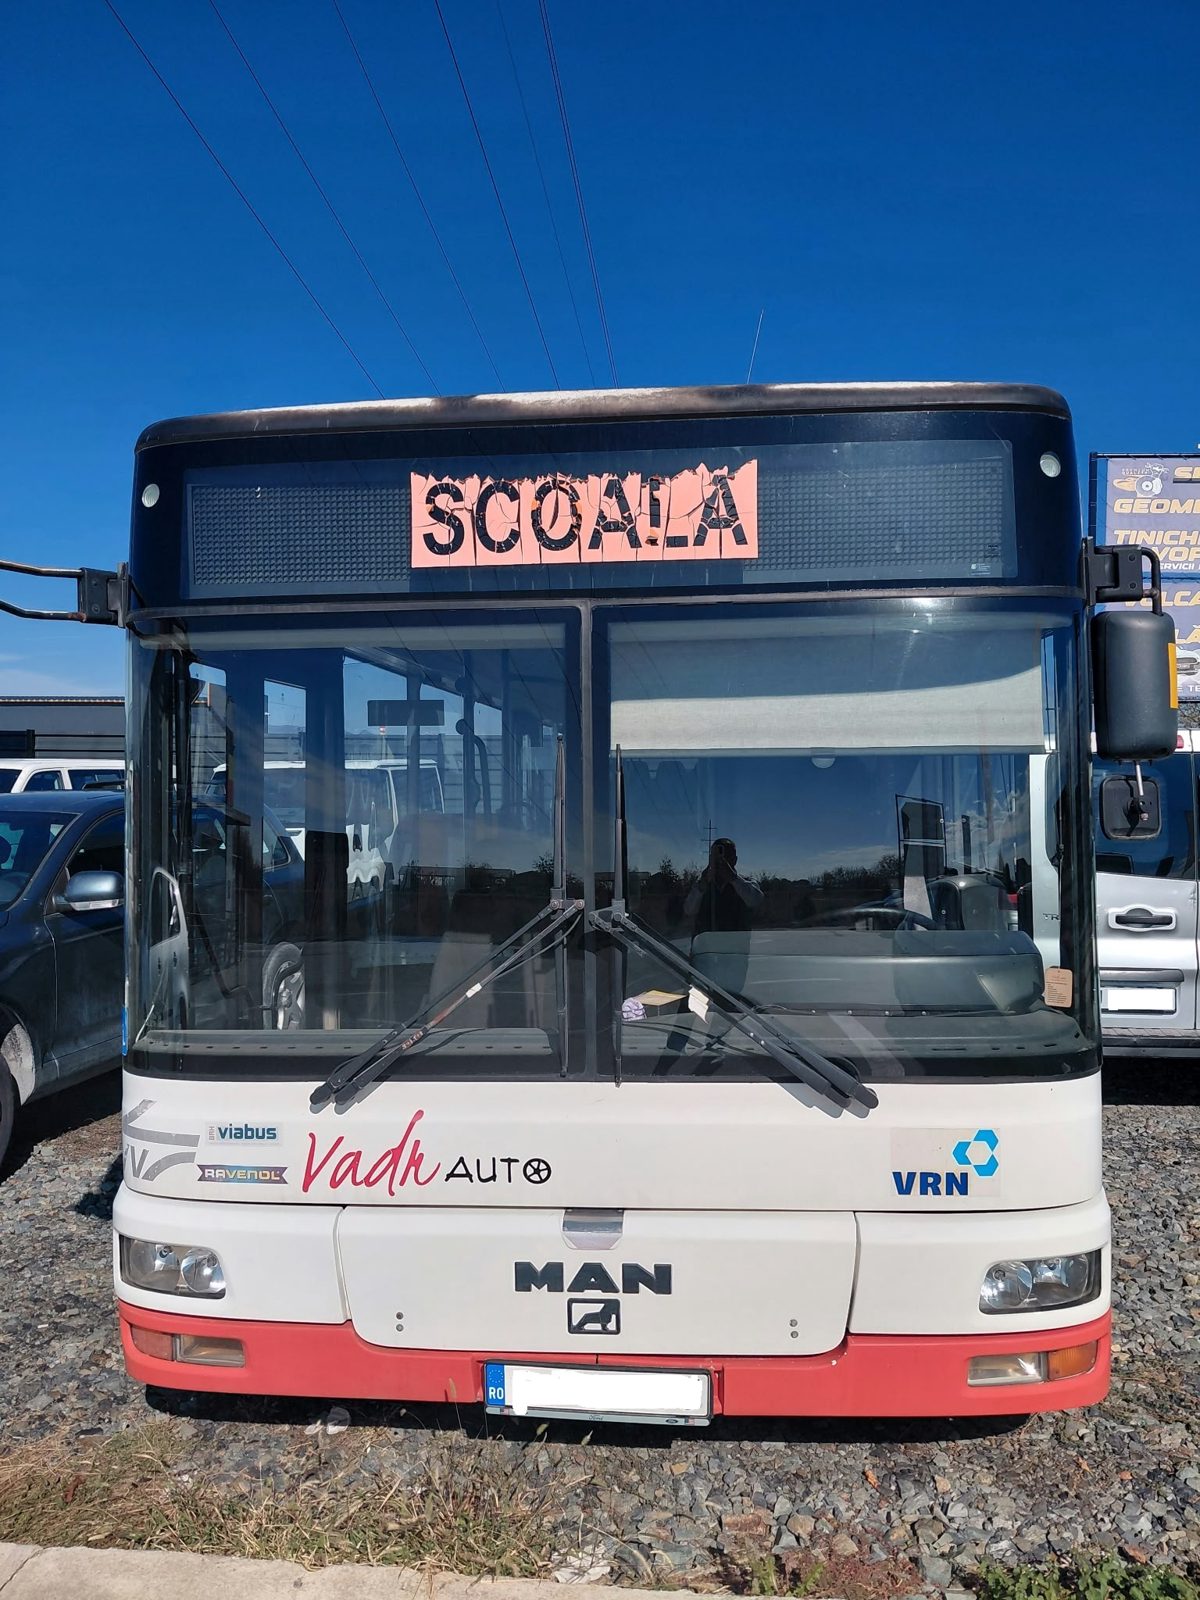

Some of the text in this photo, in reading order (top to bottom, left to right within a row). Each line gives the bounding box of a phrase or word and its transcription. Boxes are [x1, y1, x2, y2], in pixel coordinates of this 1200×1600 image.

[218, 1123, 277, 1140] viabus
[204, 1168, 281, 1180] RAVENOL
[445, 1156, 552, 1184] AUTO
[892, 1171, 969, 1196] VRN
[514, 1261, 672, 1295] MAN
[488, 1386, 505, 1400] RO
